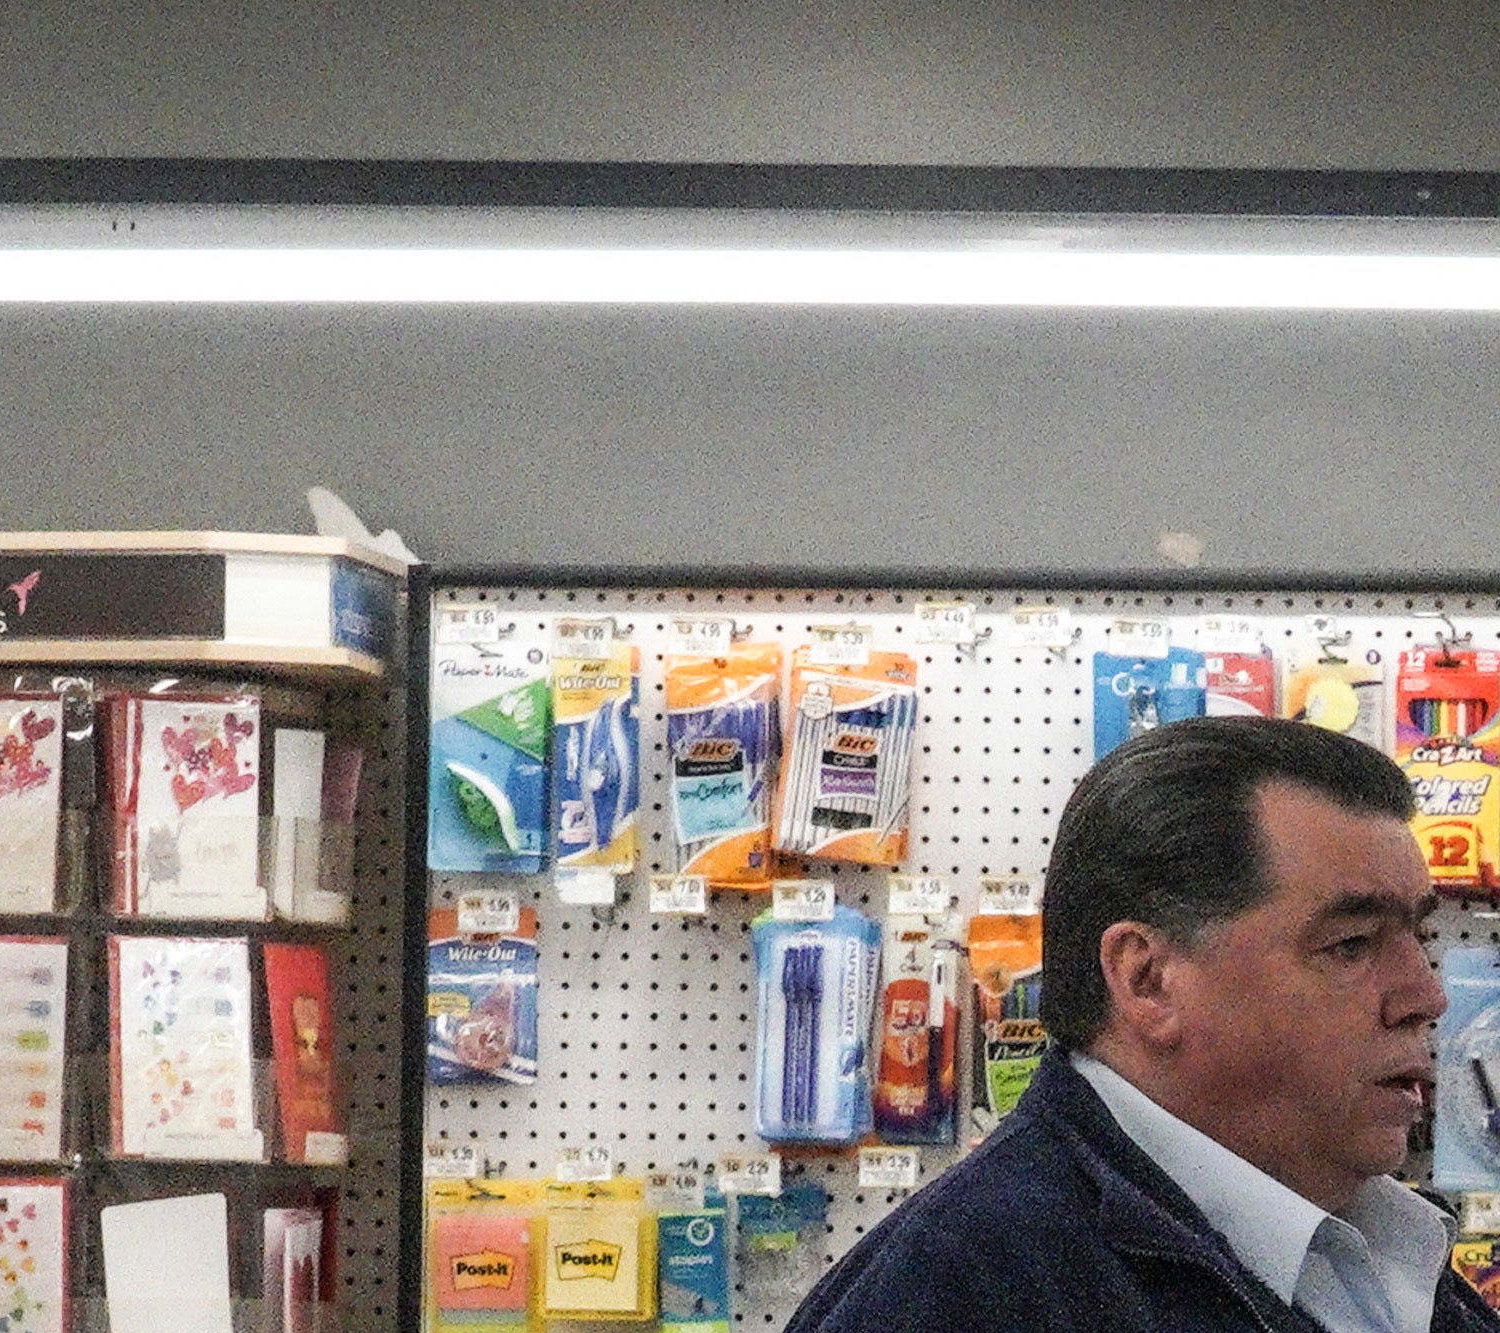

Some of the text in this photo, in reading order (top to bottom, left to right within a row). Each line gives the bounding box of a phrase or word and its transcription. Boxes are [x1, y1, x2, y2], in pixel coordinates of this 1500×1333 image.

[1428, 834, 1471, 868] 12
[560, 1248, 614, 1268] Post-it
[455, 1260, 509, 1279] Post-it
